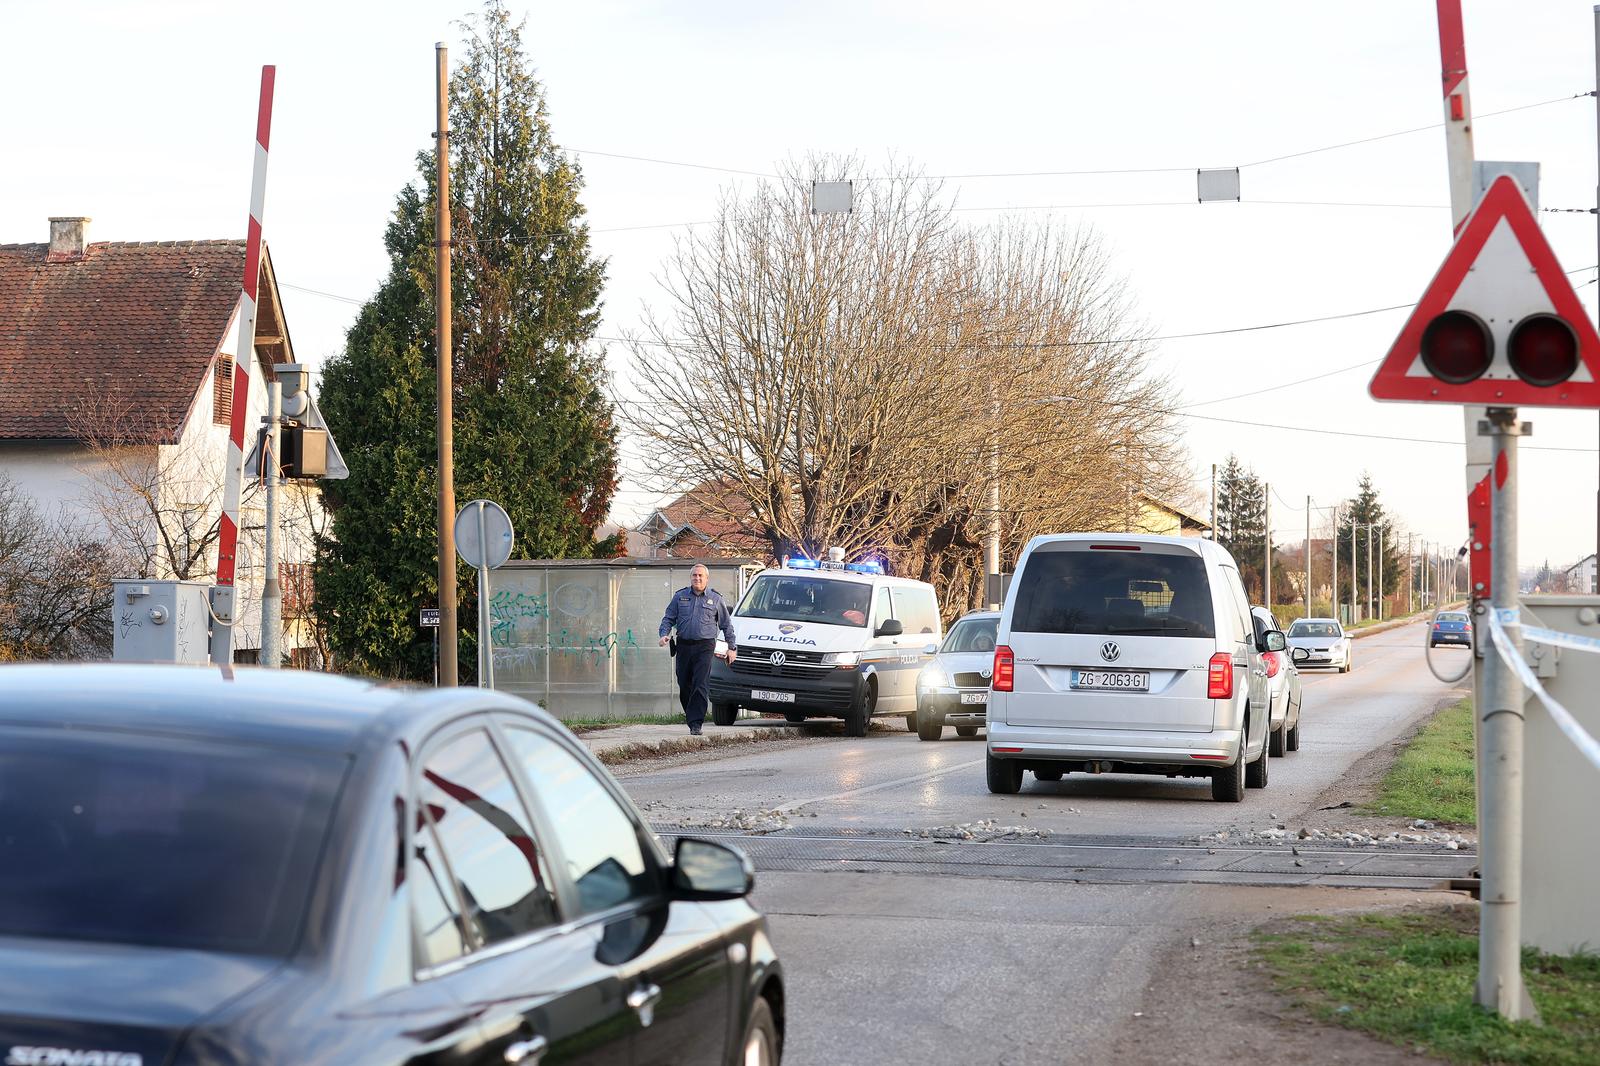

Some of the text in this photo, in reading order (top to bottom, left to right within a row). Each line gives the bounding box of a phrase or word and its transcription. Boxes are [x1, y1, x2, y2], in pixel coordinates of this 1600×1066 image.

[748, 634, 817, 647] POLICIJA
[1079, 672, 1095, 686] ZG
[966, 694, 976, 703] ZG
[4, 1045, 143, 1066] SONATA
